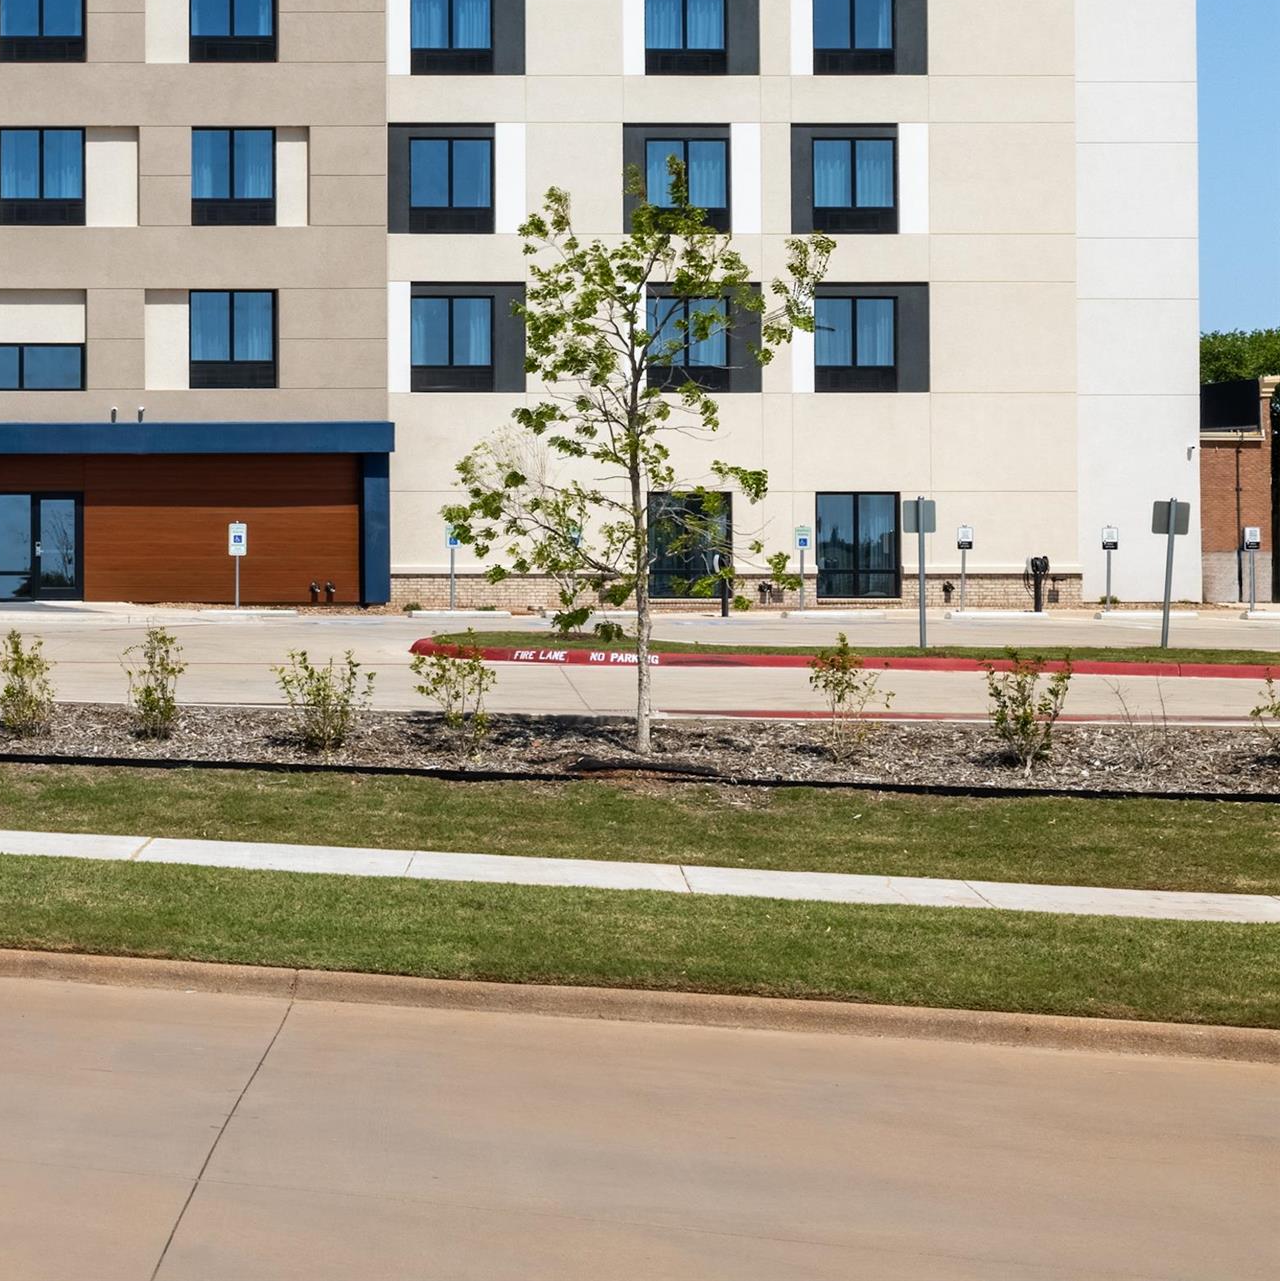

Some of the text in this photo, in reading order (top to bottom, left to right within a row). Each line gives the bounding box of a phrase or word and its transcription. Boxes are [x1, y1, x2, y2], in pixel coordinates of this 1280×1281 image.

[513, 650, 660, 664] FIRE LANE NO PARKG
